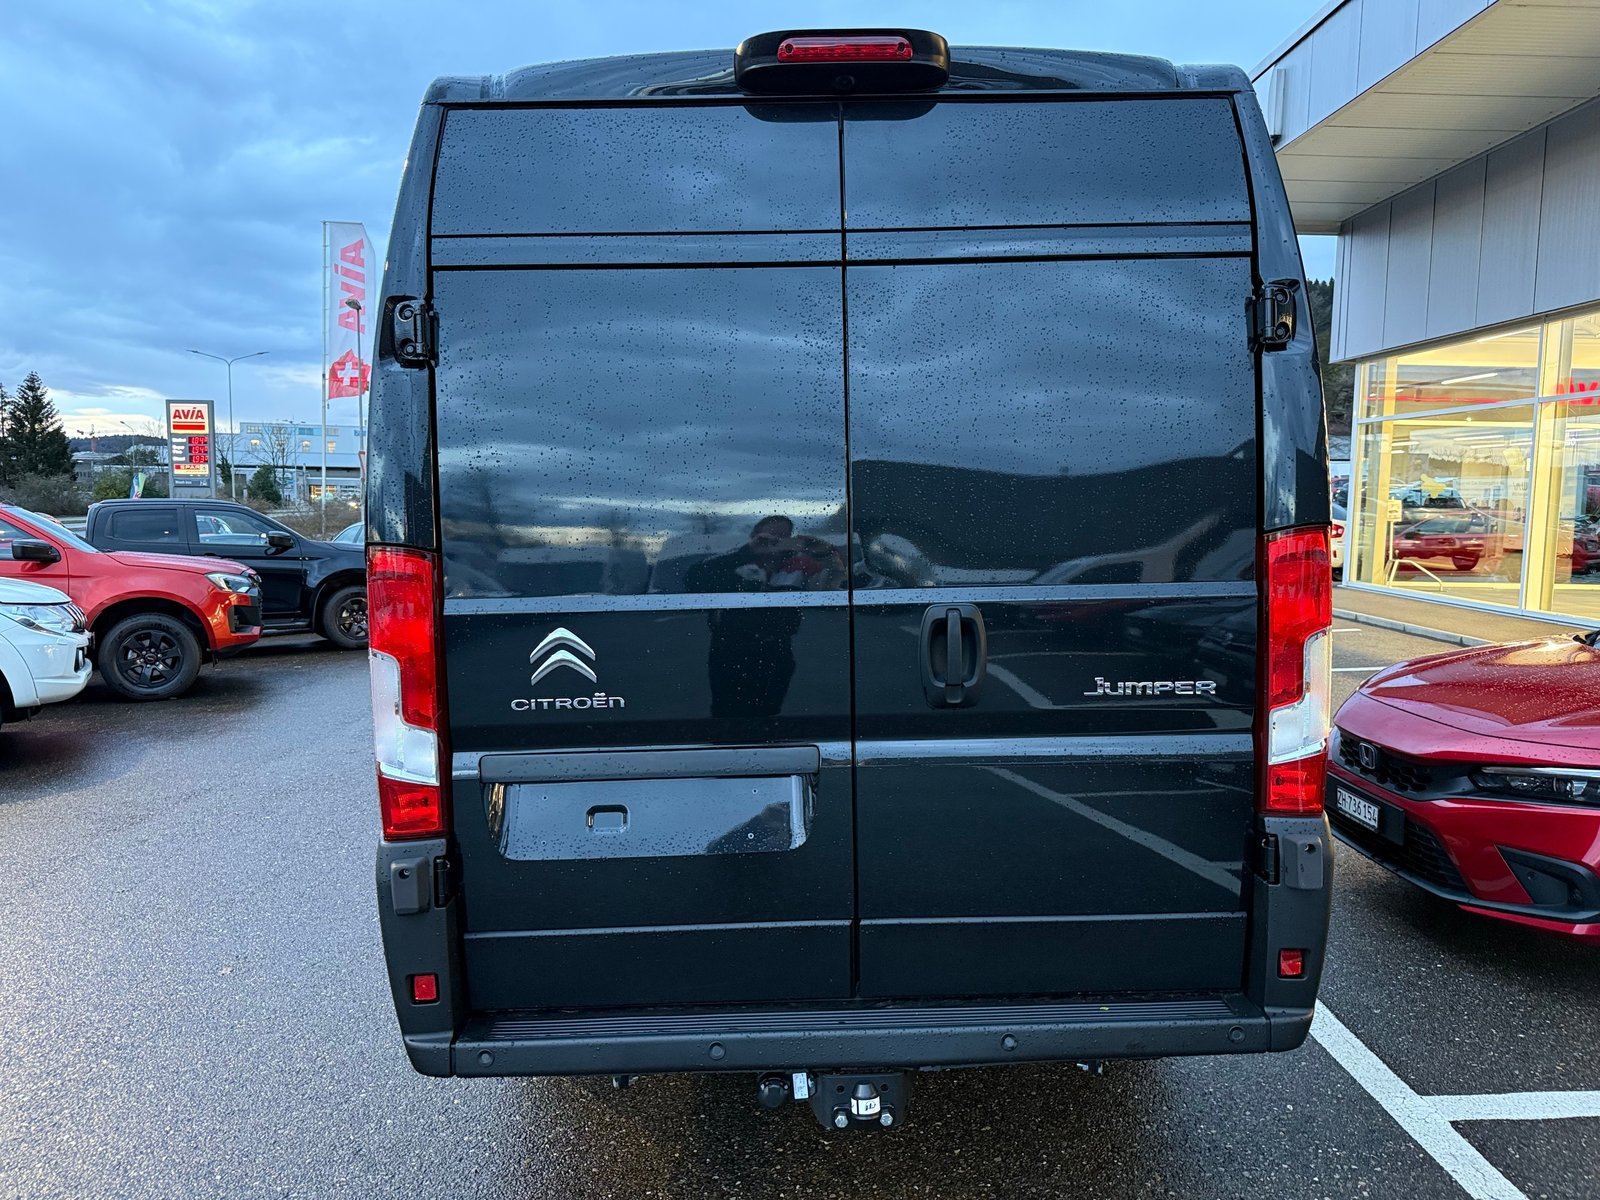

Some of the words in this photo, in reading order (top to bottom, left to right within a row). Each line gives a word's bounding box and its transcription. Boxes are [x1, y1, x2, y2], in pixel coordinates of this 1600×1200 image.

[334, 238, 366, 335] AVIA
[173, 406, 205, 420] AVIA
[1083, 676, 1217, 696] JUMPER
[511, 692, 626, 711] CITROËN
[1363, 804, 1377, 824] 154
